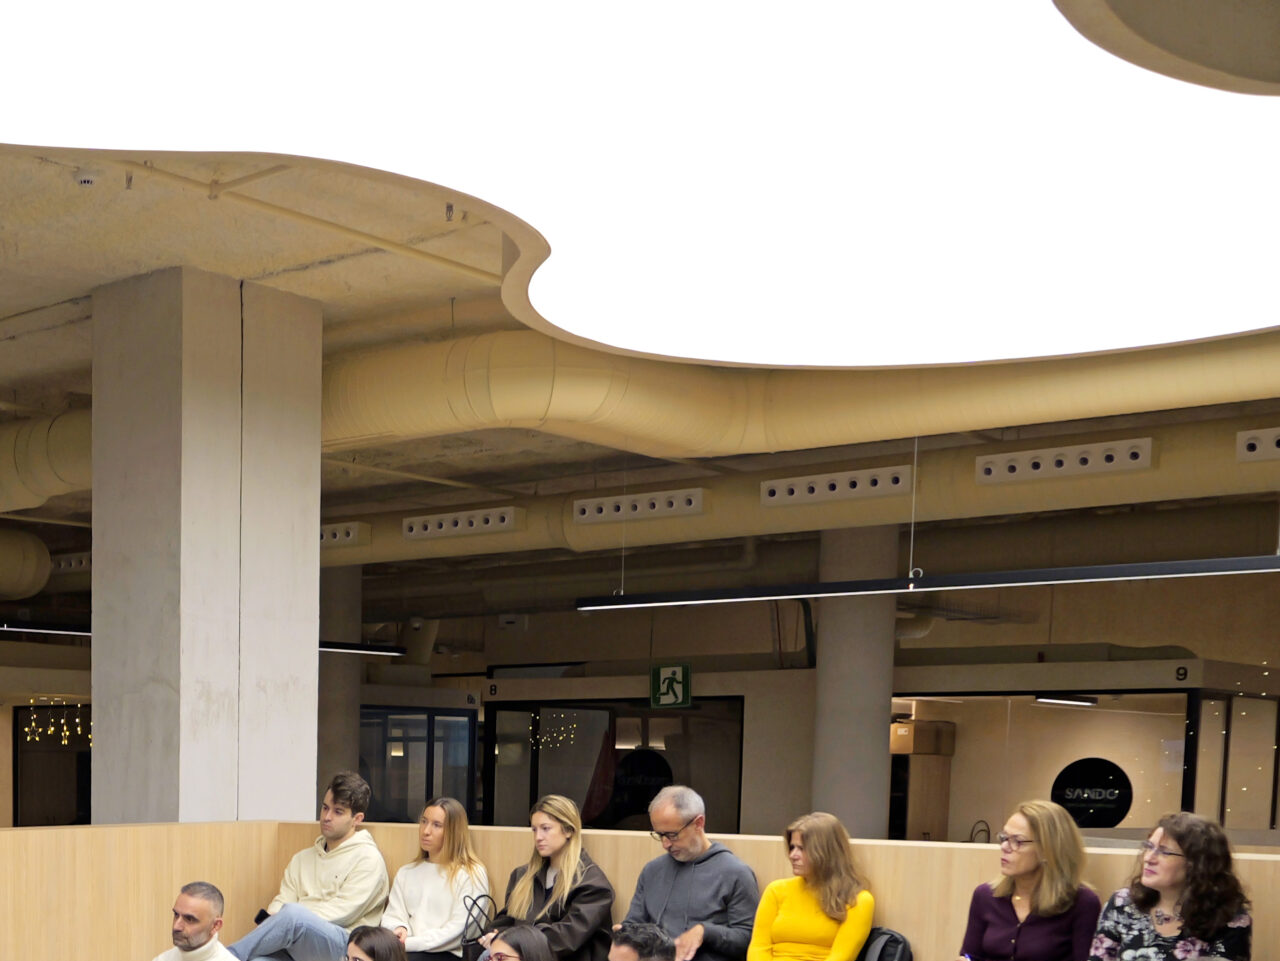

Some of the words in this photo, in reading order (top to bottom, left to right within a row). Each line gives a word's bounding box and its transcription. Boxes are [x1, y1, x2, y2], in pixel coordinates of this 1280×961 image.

[1175, 666, 1188, 681] 9
[489, 684, 497, 695] 8
[1064, 787, 1119, 800] SANDO
